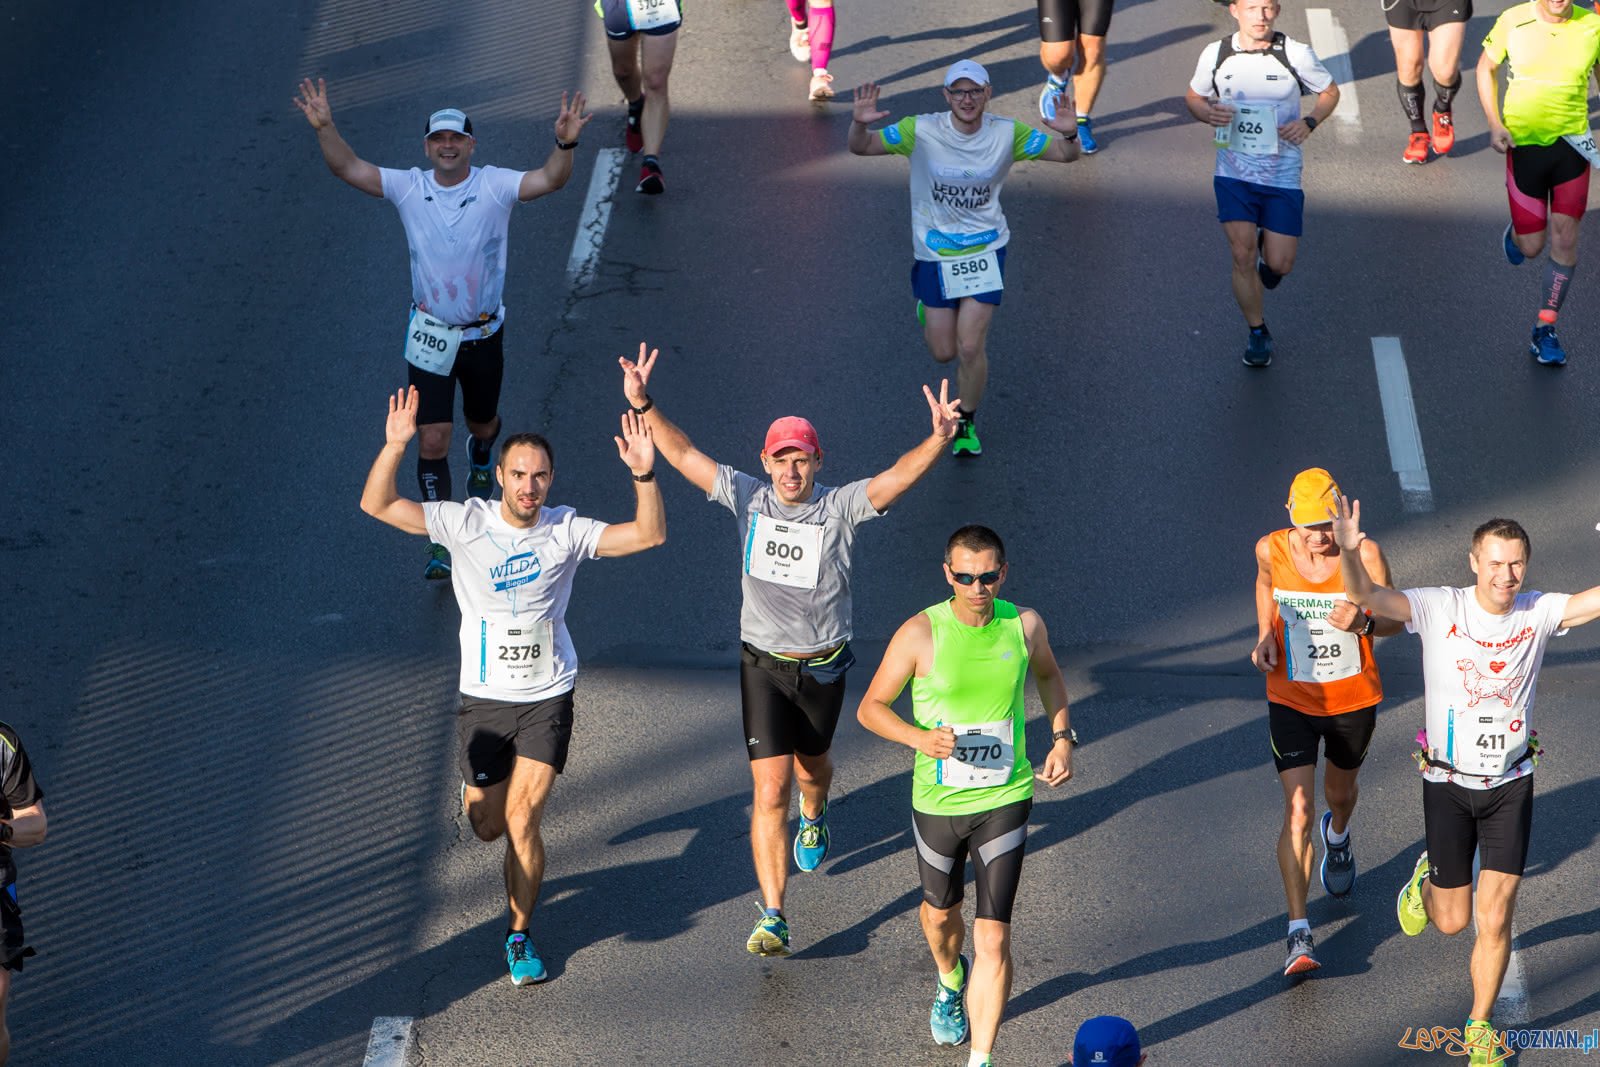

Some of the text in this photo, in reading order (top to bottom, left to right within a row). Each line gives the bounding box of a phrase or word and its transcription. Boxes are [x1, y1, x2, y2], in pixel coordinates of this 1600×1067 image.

[1238, 121, 1263, 134] 626
[1577, 137, 1597, 151] 20
[934, 181, 990, 197] LEDY NA
[932, 191, 990, 208] WYMIAR
[951, 259, 989, 276] 5580
[413, 330, 447, 352] 4180
[766, 540, 803, 561] 800
[489, 557, 541, 579] WILDA
[1296, 610, 1330, 620] KALIS
[498, 644, 541, 661] 2378
[1307, 644, 1342, 659] 228
[1476, 733, 1505, 750] 411
[956, 744, 1002, 762] 3770
